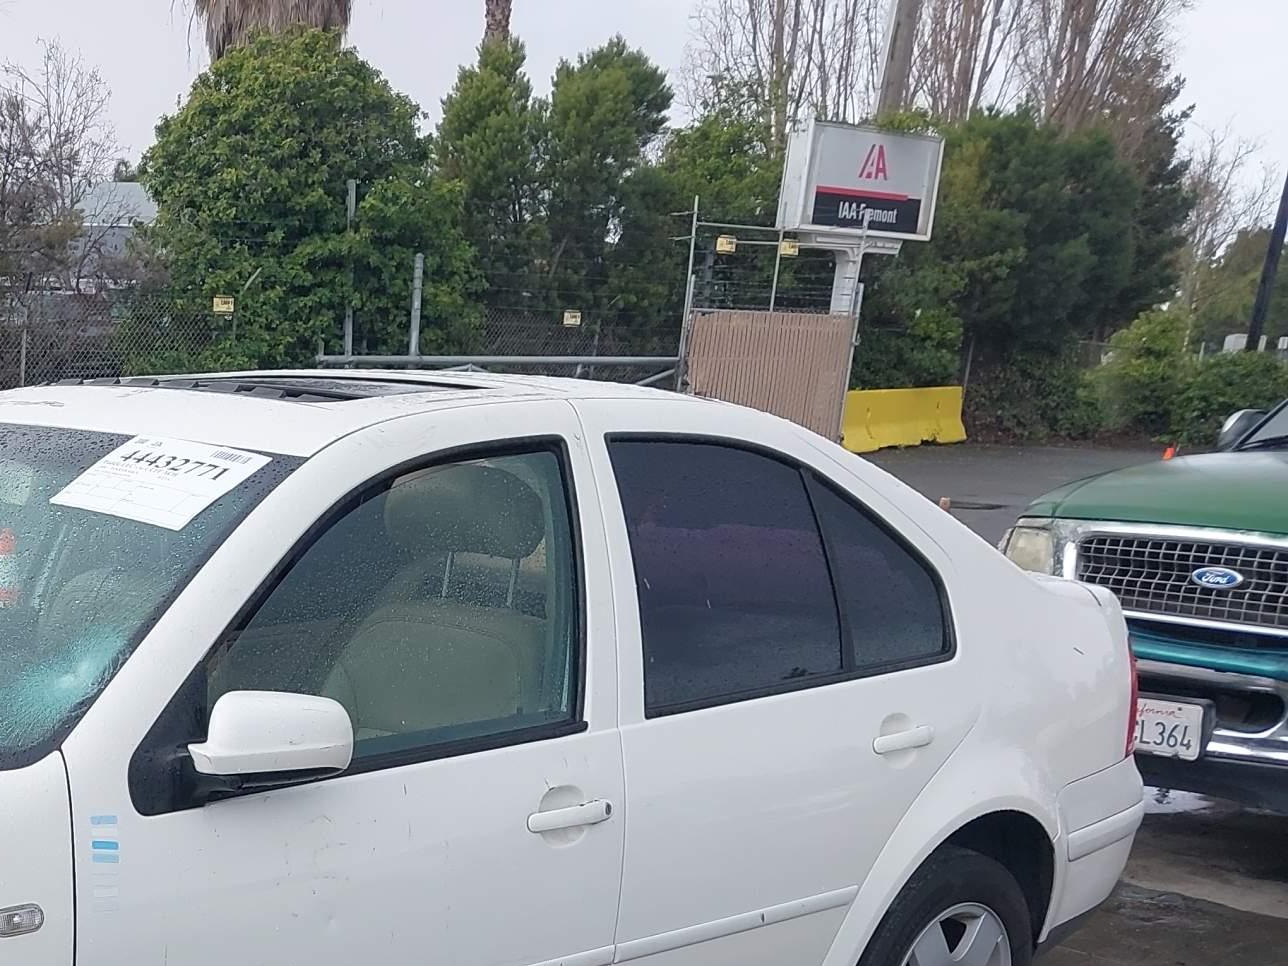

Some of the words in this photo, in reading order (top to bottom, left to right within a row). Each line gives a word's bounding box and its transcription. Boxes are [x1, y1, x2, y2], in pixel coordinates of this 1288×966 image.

[838, 201, 857, 219] IAA
[859, 203, 897, 224] Femont
[120, 449, 230, 481] 44432771
[1202, 571, 1231, 584] Ford
[1137, 703, 1185, 718] fornia
[1134, 719, 1192, 751] L364
